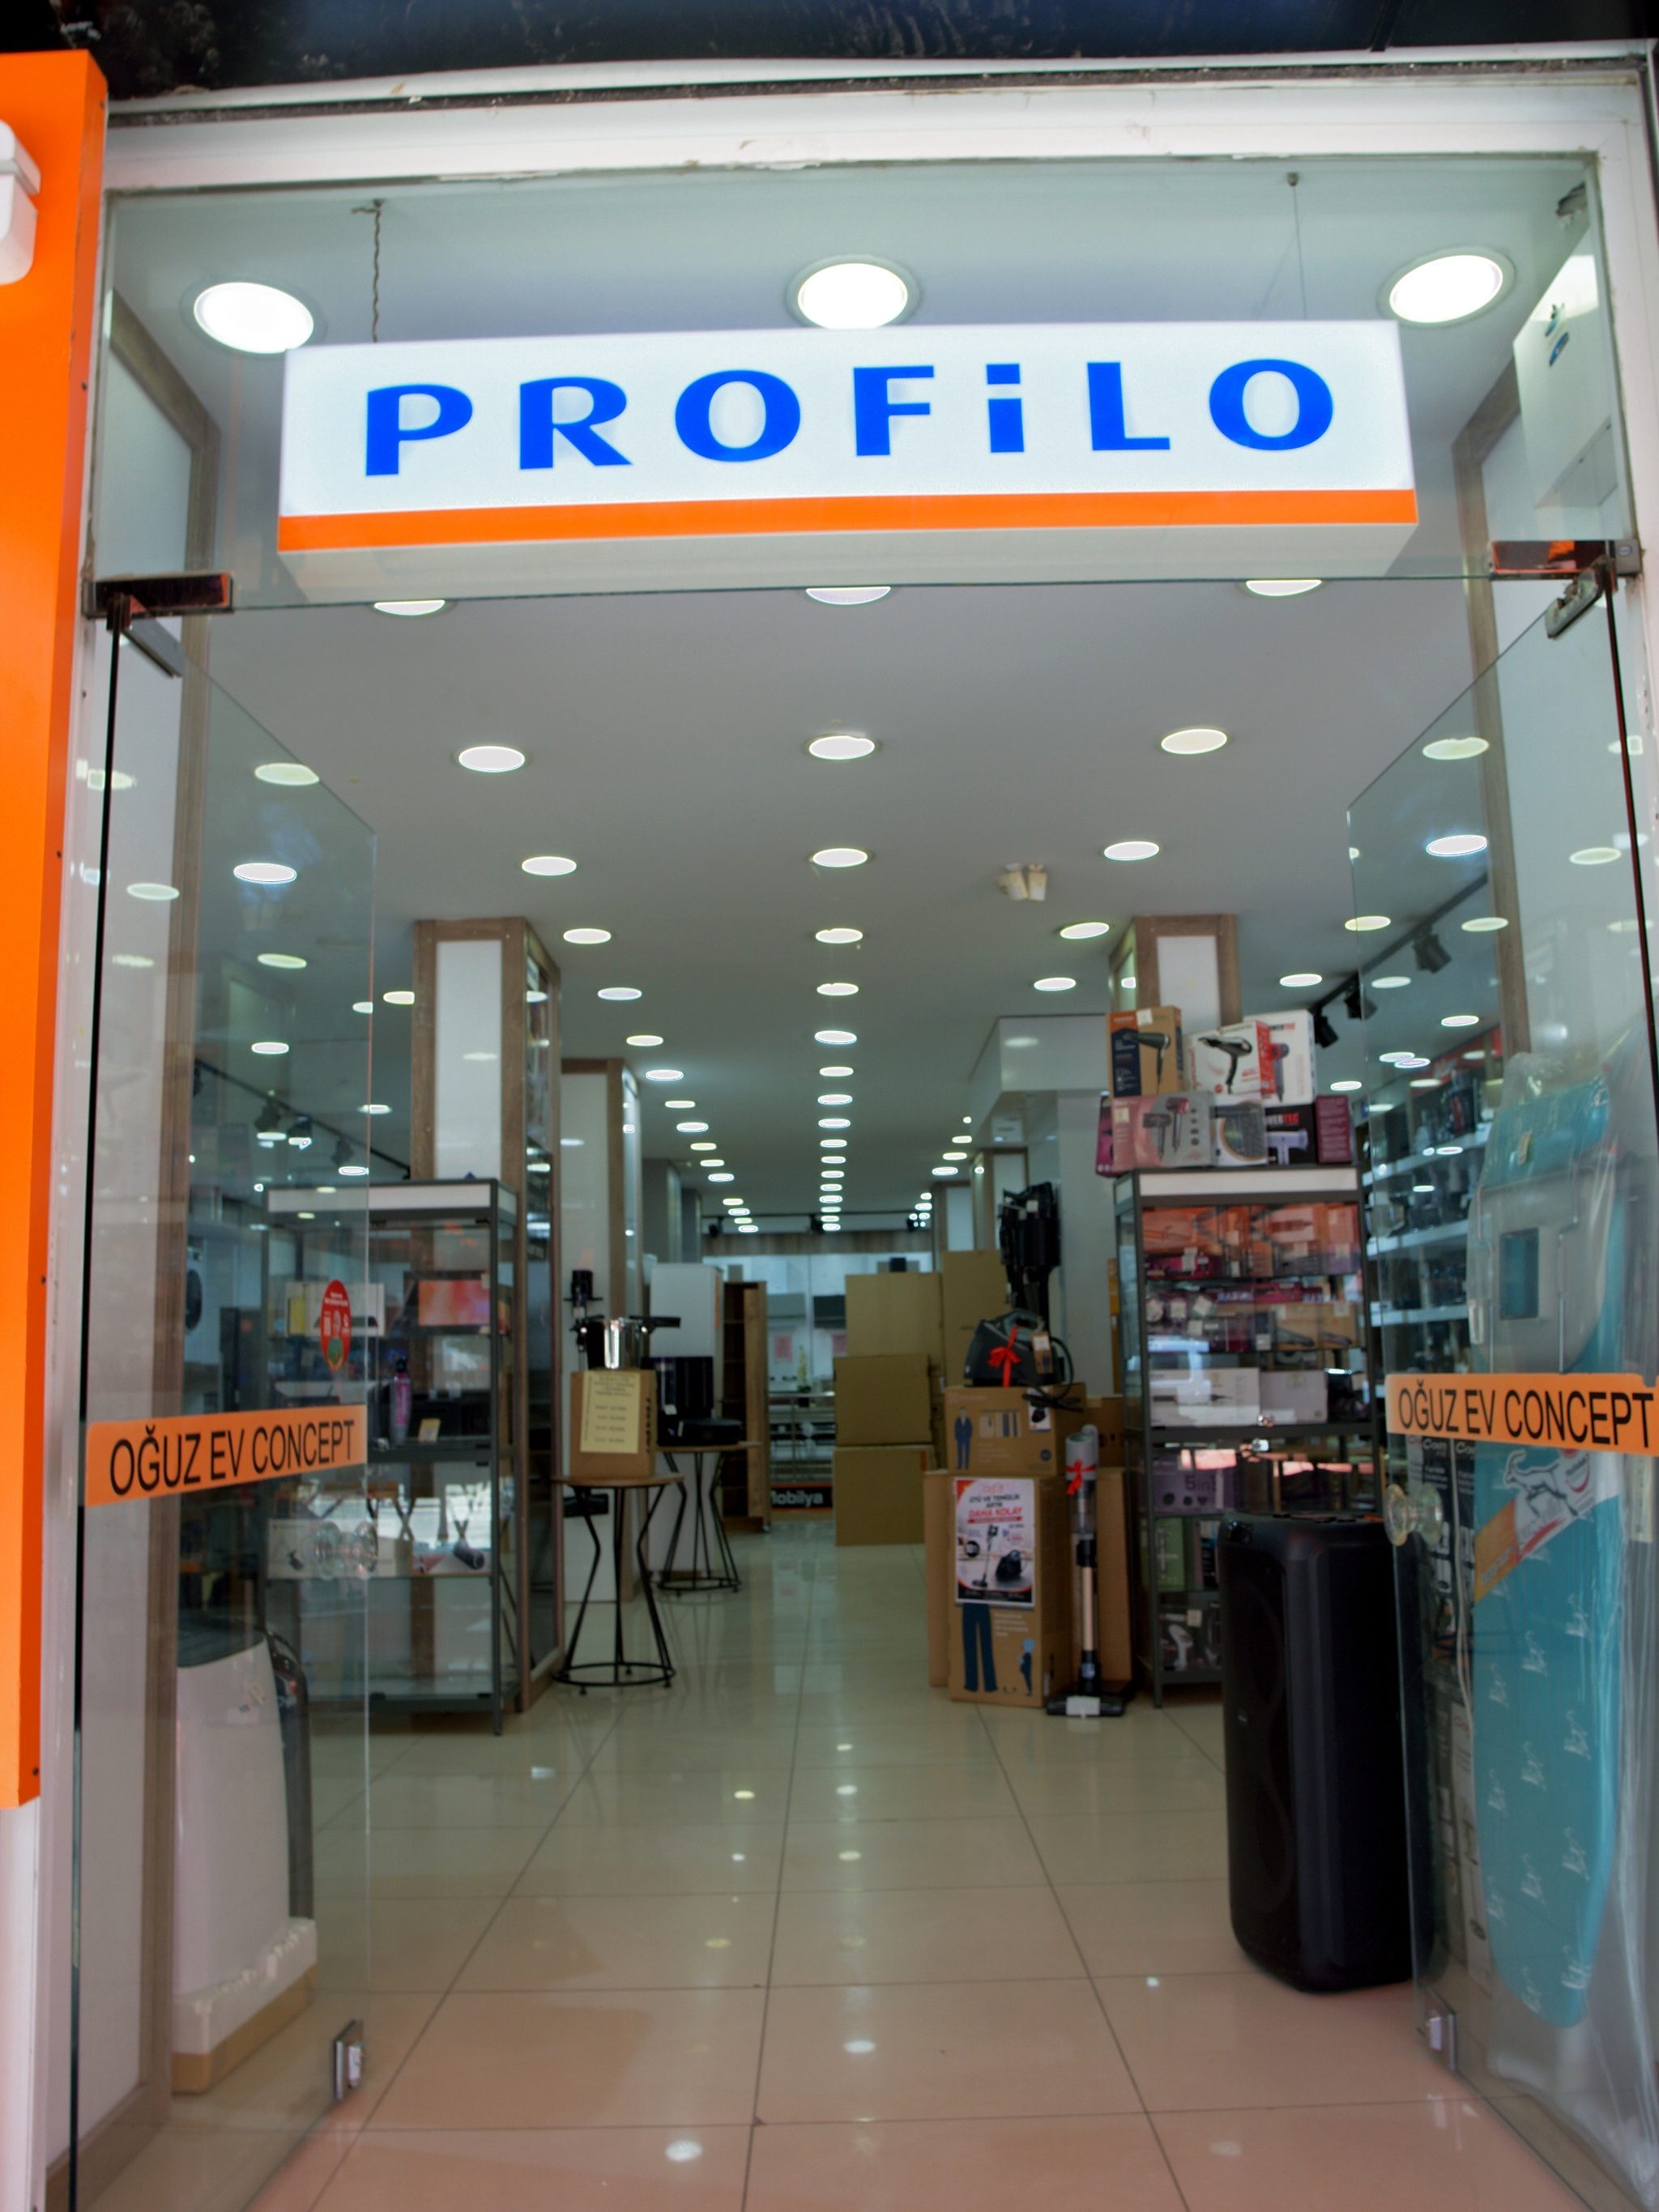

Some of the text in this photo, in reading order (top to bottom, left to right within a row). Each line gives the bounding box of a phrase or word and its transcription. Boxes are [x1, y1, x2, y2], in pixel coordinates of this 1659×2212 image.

[1398, 1379, 1654, 1448] OĞUZ EV CONCEPT
[109, 1419, 355, 1496] OĞUZ EV CONCEPT
